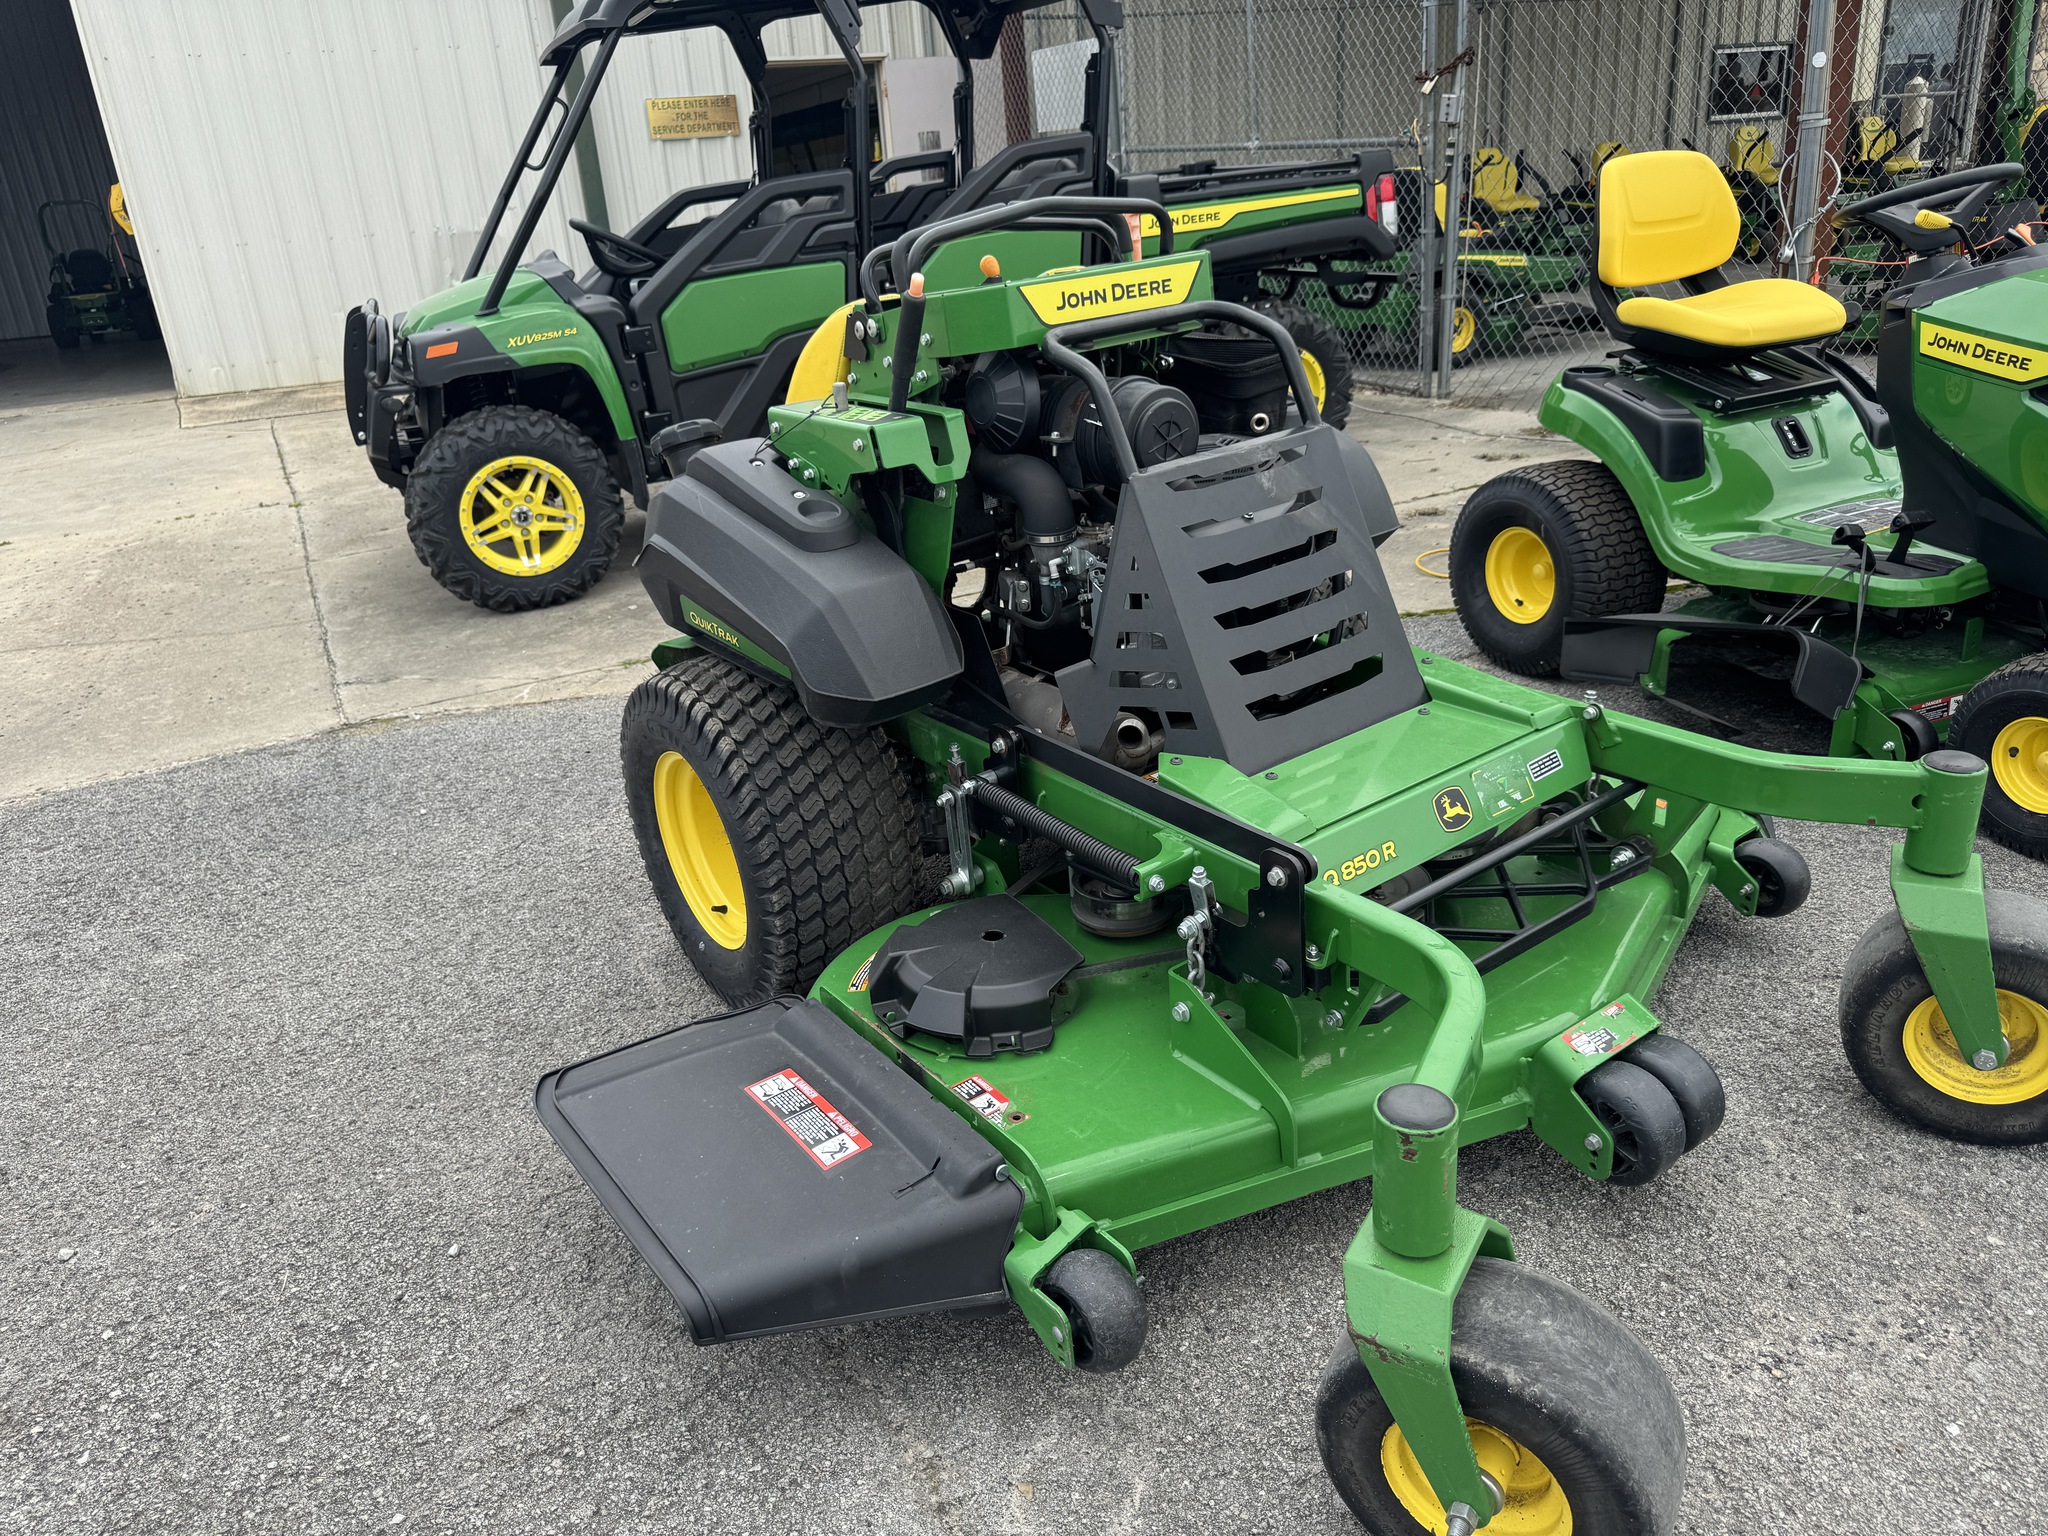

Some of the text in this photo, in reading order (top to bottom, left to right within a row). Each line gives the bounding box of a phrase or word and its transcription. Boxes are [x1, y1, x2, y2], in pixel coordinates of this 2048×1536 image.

[651, 97, 731, 111] PLEASE ENTER HERE
[675, 111, 709, 122] FOR THE
[652, 121, 737, 136] SERVICE DEPARTMENT
[1148, 212, 1221, 230] JON DEERE
[1056, 278, 1172, 311] JOHN DEERE
[507, 327, 578, 348] XUV825M S4
[1927, 332, 2033, 372] JOHN DEERE
[689, 611, 741, 648] QUIKTRAK
[1340, 847, 1381, 882] 850
[1381, 840, 1398, 863] R
[1865, 974, 1917, 1070] RELIANCE
[835, 1115, 860, 1137] PELIGRO
